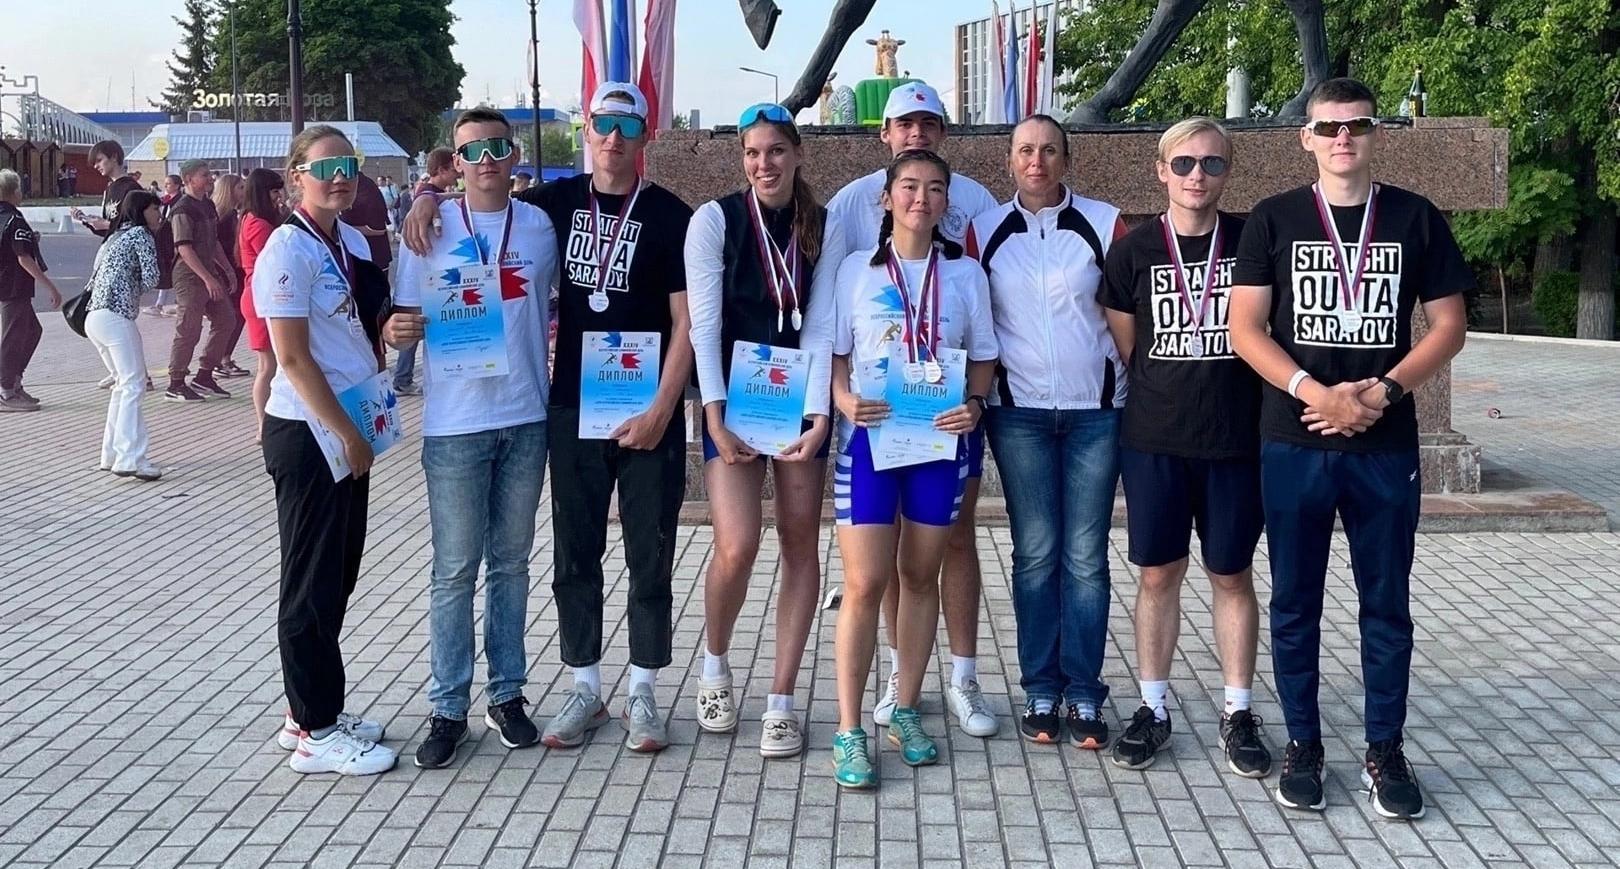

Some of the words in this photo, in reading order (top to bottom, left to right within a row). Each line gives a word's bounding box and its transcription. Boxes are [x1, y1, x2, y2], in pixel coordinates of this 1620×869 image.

[192, 88, 280, 109] Золотая
[1297, 245, 1397, 272] STRIGHT
[568, 262, 623, 288] SARAOV
[1299, 275, 1394, 314] OUTA
[440, 306, 487, 323] ДИПЛОМ
[597, 370, 643, 382] ДИПЛОМ
[744, 382, 790, 398] ДИПЛОМ
[902, 383, 948, 398] ДИПЛОМ
[360, 400, 376, 444] ДИПЛОМ
